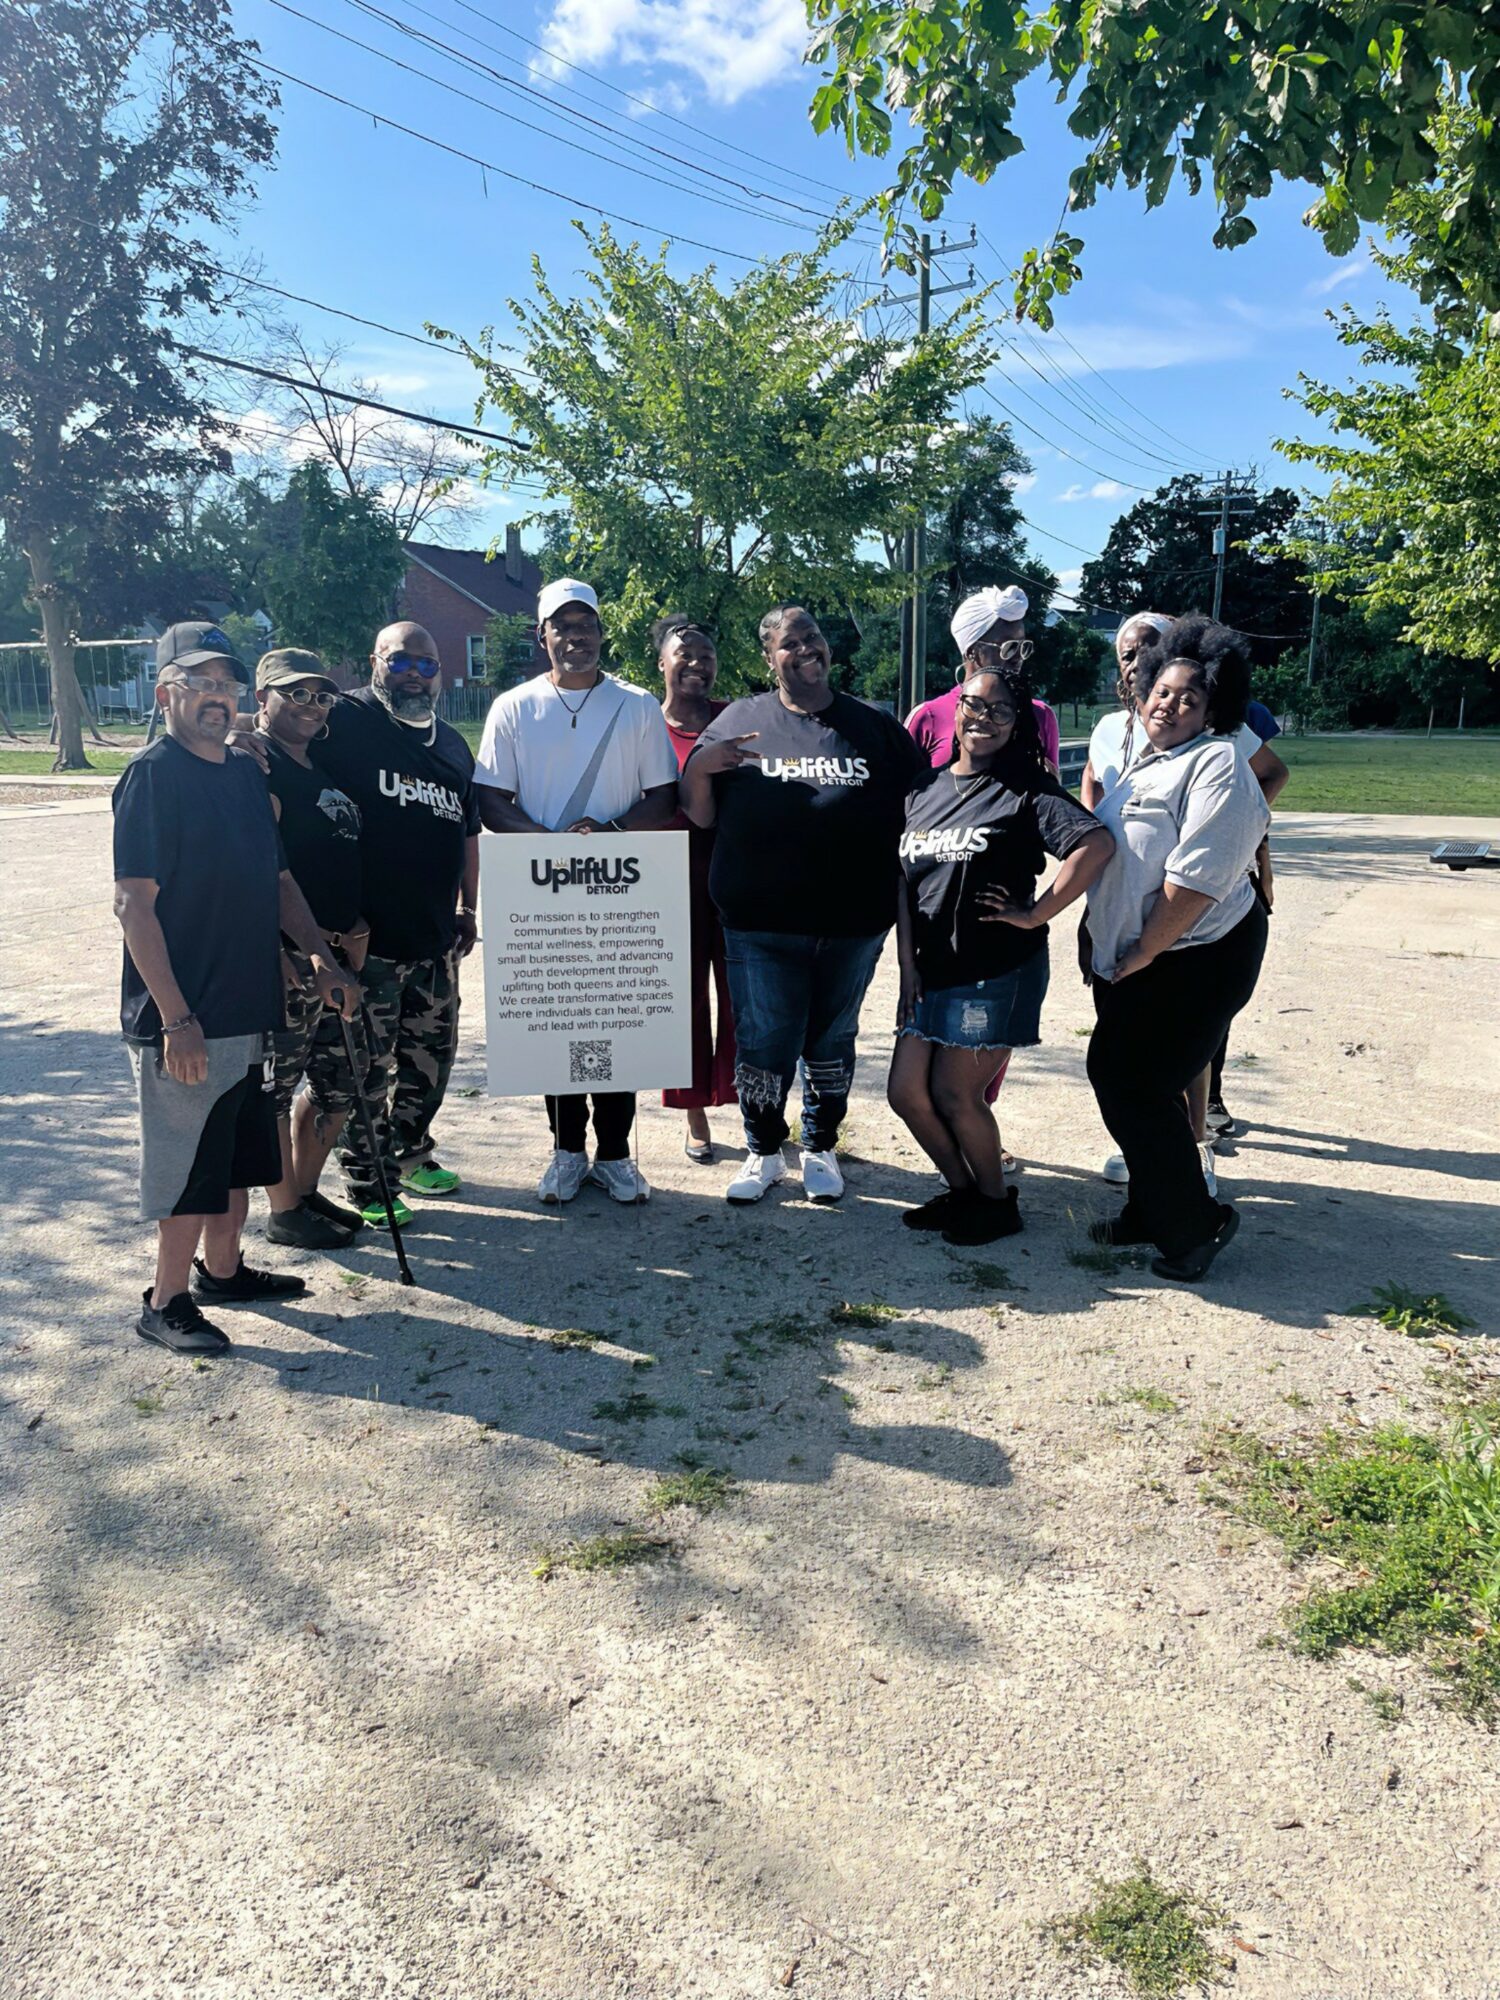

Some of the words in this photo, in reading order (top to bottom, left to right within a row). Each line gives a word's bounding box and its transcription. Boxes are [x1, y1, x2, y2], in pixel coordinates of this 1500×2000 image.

[761, 757, 870, 782] UpliftUS
[820, 778, 863, 786] DETROIT
[899, 827, 991, 863] UpliftUS
[935, 851, 974, 862] DETROIT
[531, 857, 640, 893] UpliftUS
[586, 884, 630, 895] DETROIT
[509, 913, 530, 923] Our
[534, 912, 574, 922] mission
[578, 912, 587, 921] is
[590, 912, 600, 921] to
[603, 910, 660, 922] strengthen
[514, 927, 583, 937] communities
[586, 925, 598, 937] by
[602, 925, 656, 936] prioritizing
[507, 940, 543, 950] mental
[546, 939, 596, 949] wellness,
[599, 939, 664, 950] empowering
[498, 954, 526, 965] small
[529, 954, 592, 964] businesses,
[596, 952, 616, 961] and
[620, 951, 673, 961] advancing
[513, 968, 543, 980] youth
[546, 966, 615, 978] development
[618, 964, 658, 976] through
[502, 980, 544, 993] uplifting
[547, 981, 571, 990] both
[574, 981, 613, 992] queens
[616, 978, 636, 988] and
[639, 977, 669, 989] kings.
[499, 996, 517, 1006] We
[521, 996, 554, 1005] create
[558, 993, 633, 1004] transformative
[636, 992, 673, 1002] spaces
[499, 1009, 532, 1019] where
[536, 1007, 592, 1017] individuals
[595, 1007, 614, 1015] can
[618, 1005, 643, 1015] heal,
[646, 1006, 673, 1016] grow,
[528, 1022, 548, 1031] and
[551, 1021, 574, 1031] lead
[577, 1020, 598, 1030] with
[602, 1020, 646, 1031] purpose.
